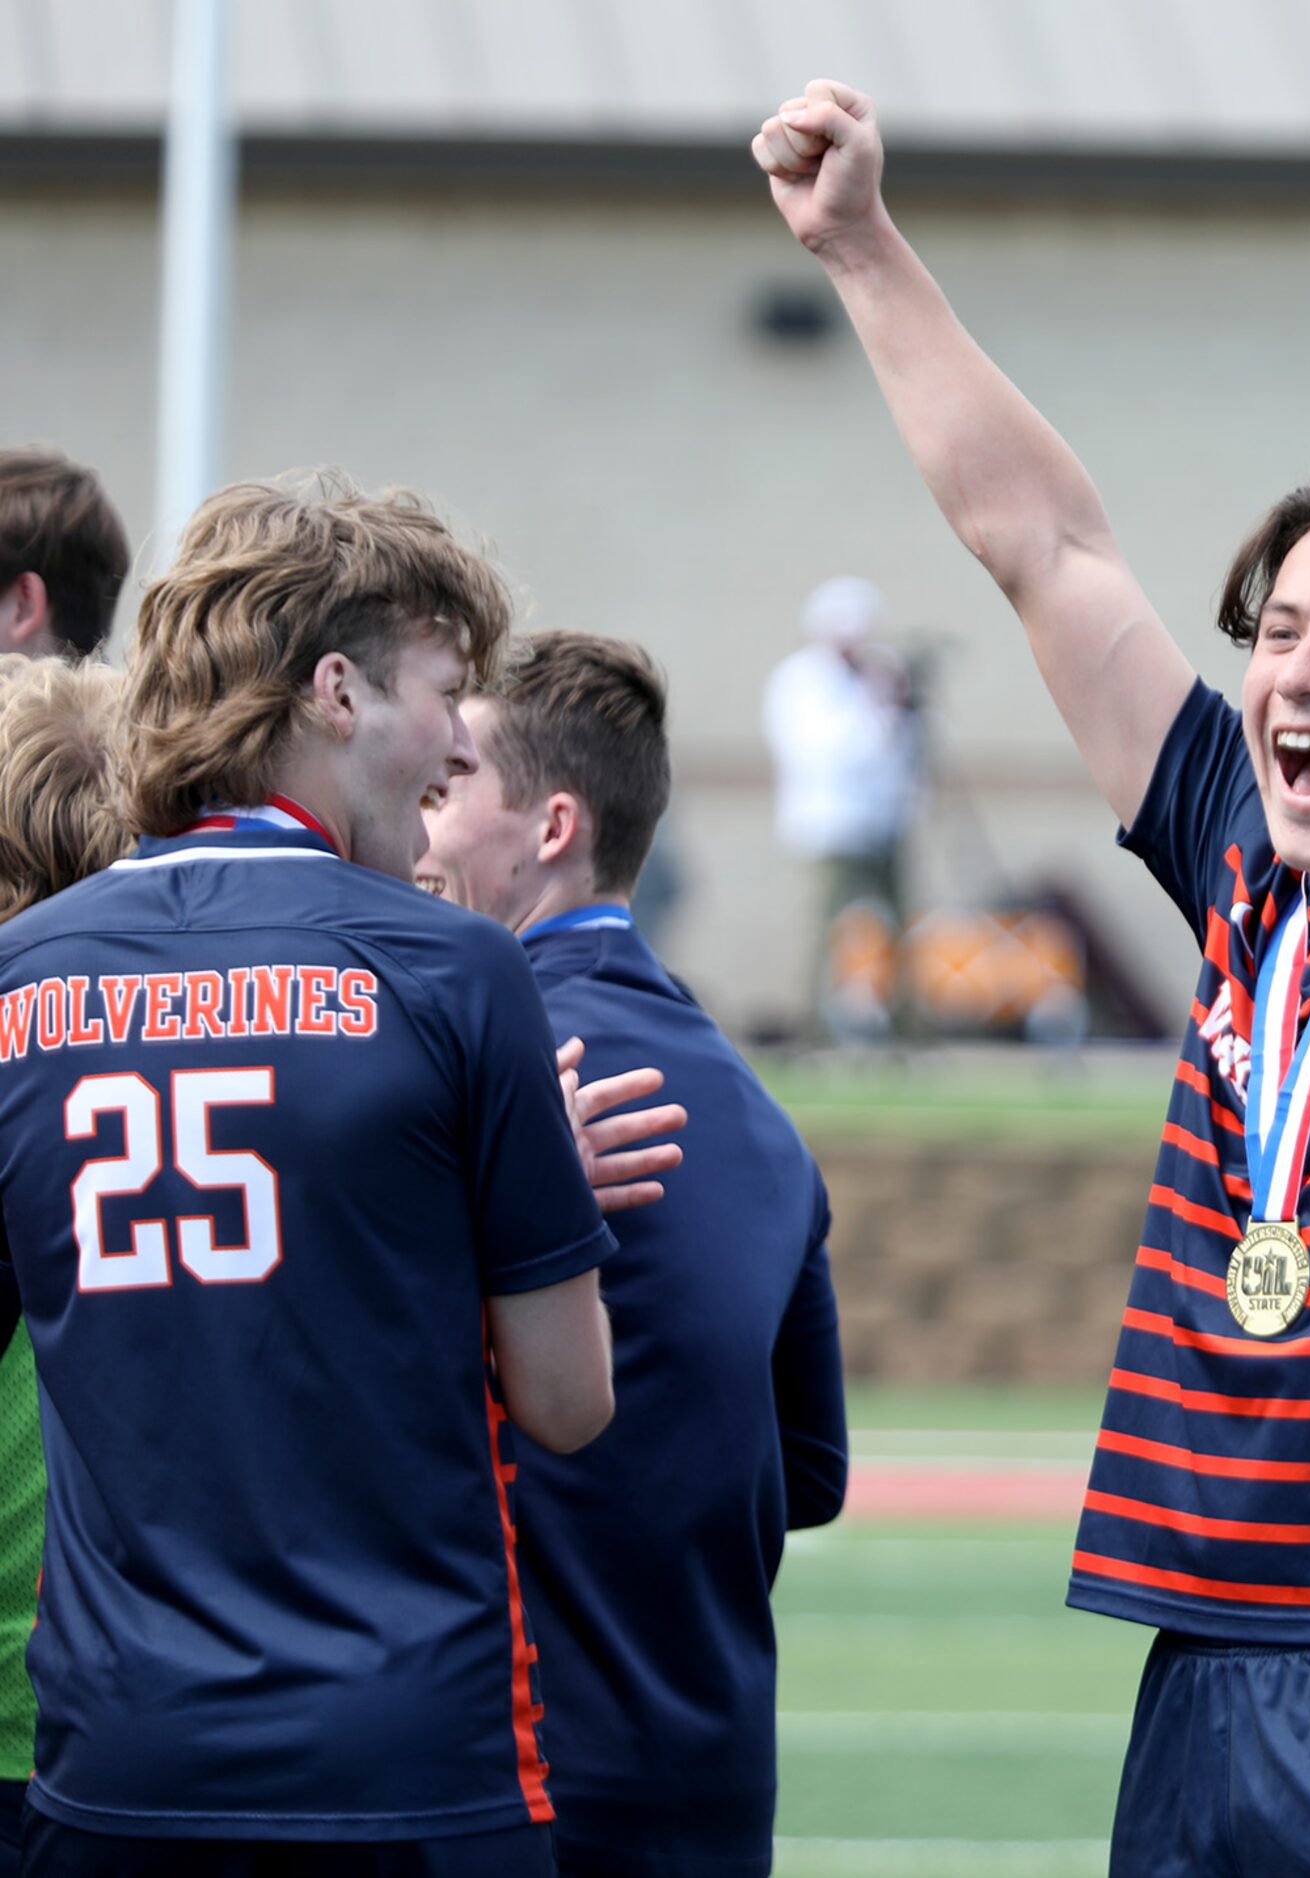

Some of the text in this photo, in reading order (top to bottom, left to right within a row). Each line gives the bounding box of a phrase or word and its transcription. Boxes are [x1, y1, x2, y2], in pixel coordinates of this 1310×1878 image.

[0, 964, 379, 1063] WOLVERINES
[63, 1065, 283, 1294] 25
[1249, 1297, 1282, 1311] STATE
